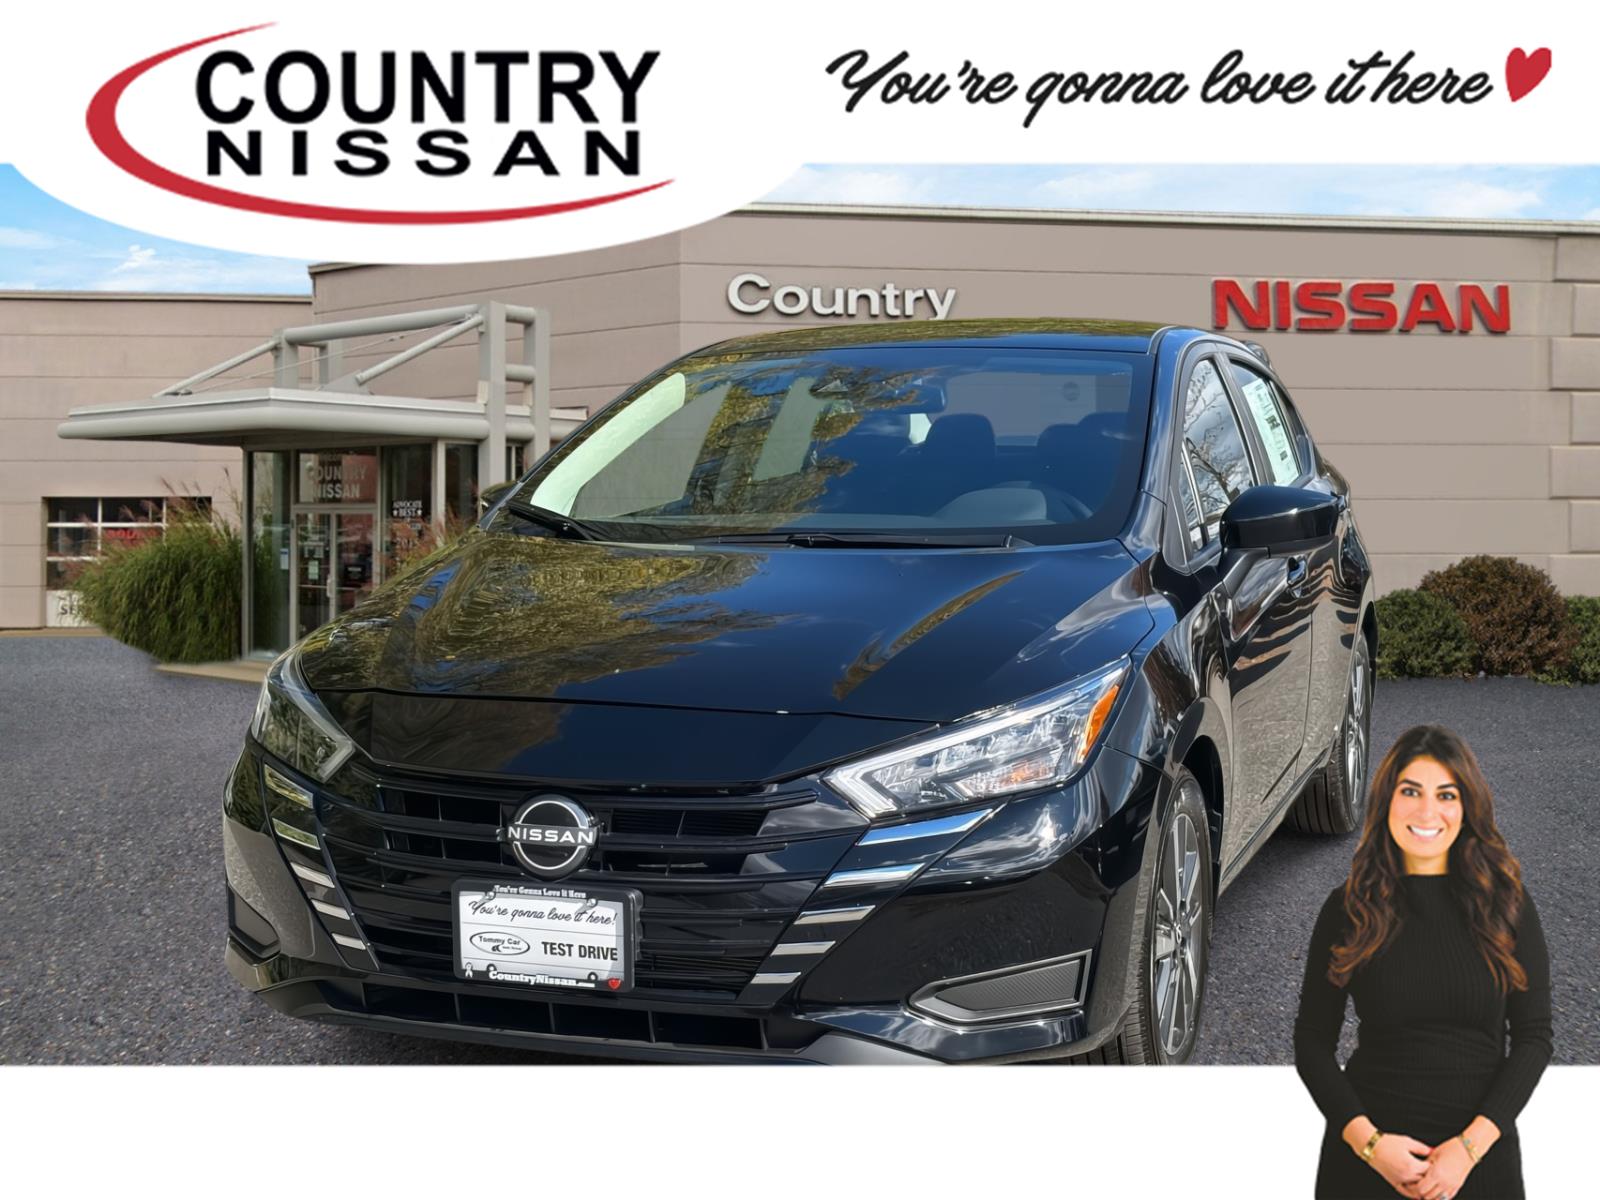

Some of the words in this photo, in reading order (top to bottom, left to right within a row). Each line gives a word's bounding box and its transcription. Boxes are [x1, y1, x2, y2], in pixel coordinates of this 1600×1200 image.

[727, 272, 956, 320] Country
[1213, 278, 1512, 334] NISSAN
[307, 464, 368, 481] OUNTRY
[508, 826, 594, 844] NISSAN
[468, 900, 509, 916] You're
[510, 909, 545, 922] gonna
[547, 907, 572, 921] love
[585, 910, 618, 925] here!
[541, 941, 574, 957] TEST
[578, 945, 619, 961] DRIVE
